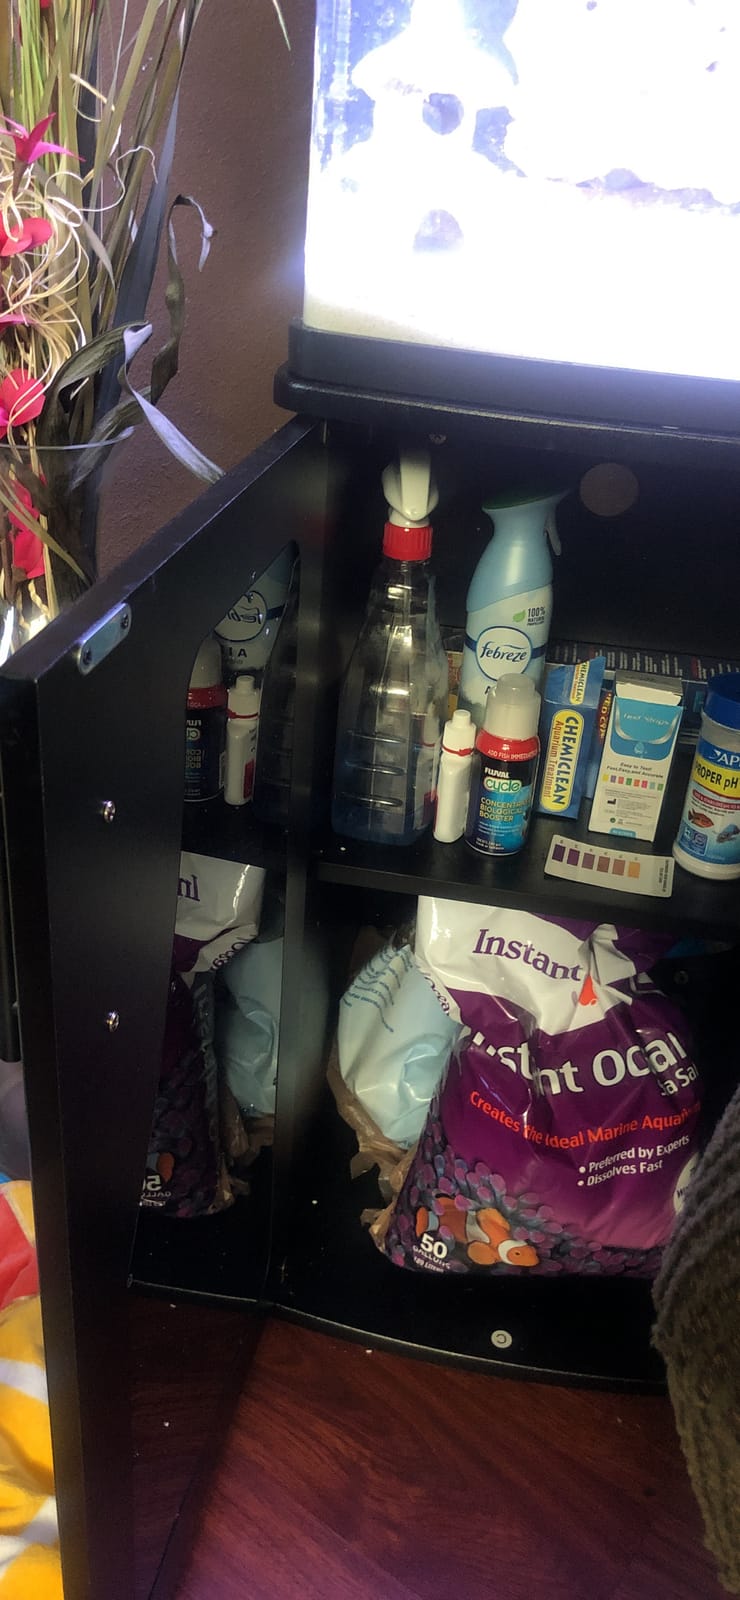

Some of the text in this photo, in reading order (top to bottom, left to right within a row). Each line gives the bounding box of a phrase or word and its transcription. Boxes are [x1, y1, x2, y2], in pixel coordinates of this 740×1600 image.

[527, 607, 546, 617] 100%
[480, 640, 528, 663] febreze
[543, 720, 565, 798] Aquarium Treatment
[551, 716, 579, 805] CHEMICLEAN
[717, 753, 740, 767] AP
[484, 766, 509, 779] FLUVAL
[723, 777, 739, 790] pH
[485, 780, 521, 792] cycle
[479, 810, 514, 822] BOOSTER
[472, 928, 583, 981] Instant
[470, 1091, 520, 1133] Creates
[544, 1136, 584, 1149] Ideal
[587, 1118, 639, 1144] Marine
[588, 1135, 689, 1173] Preferred by Experts
[586, 1159, 663, 1186] Dissolves Fast
[420, 1232, 448, 1259] 50
